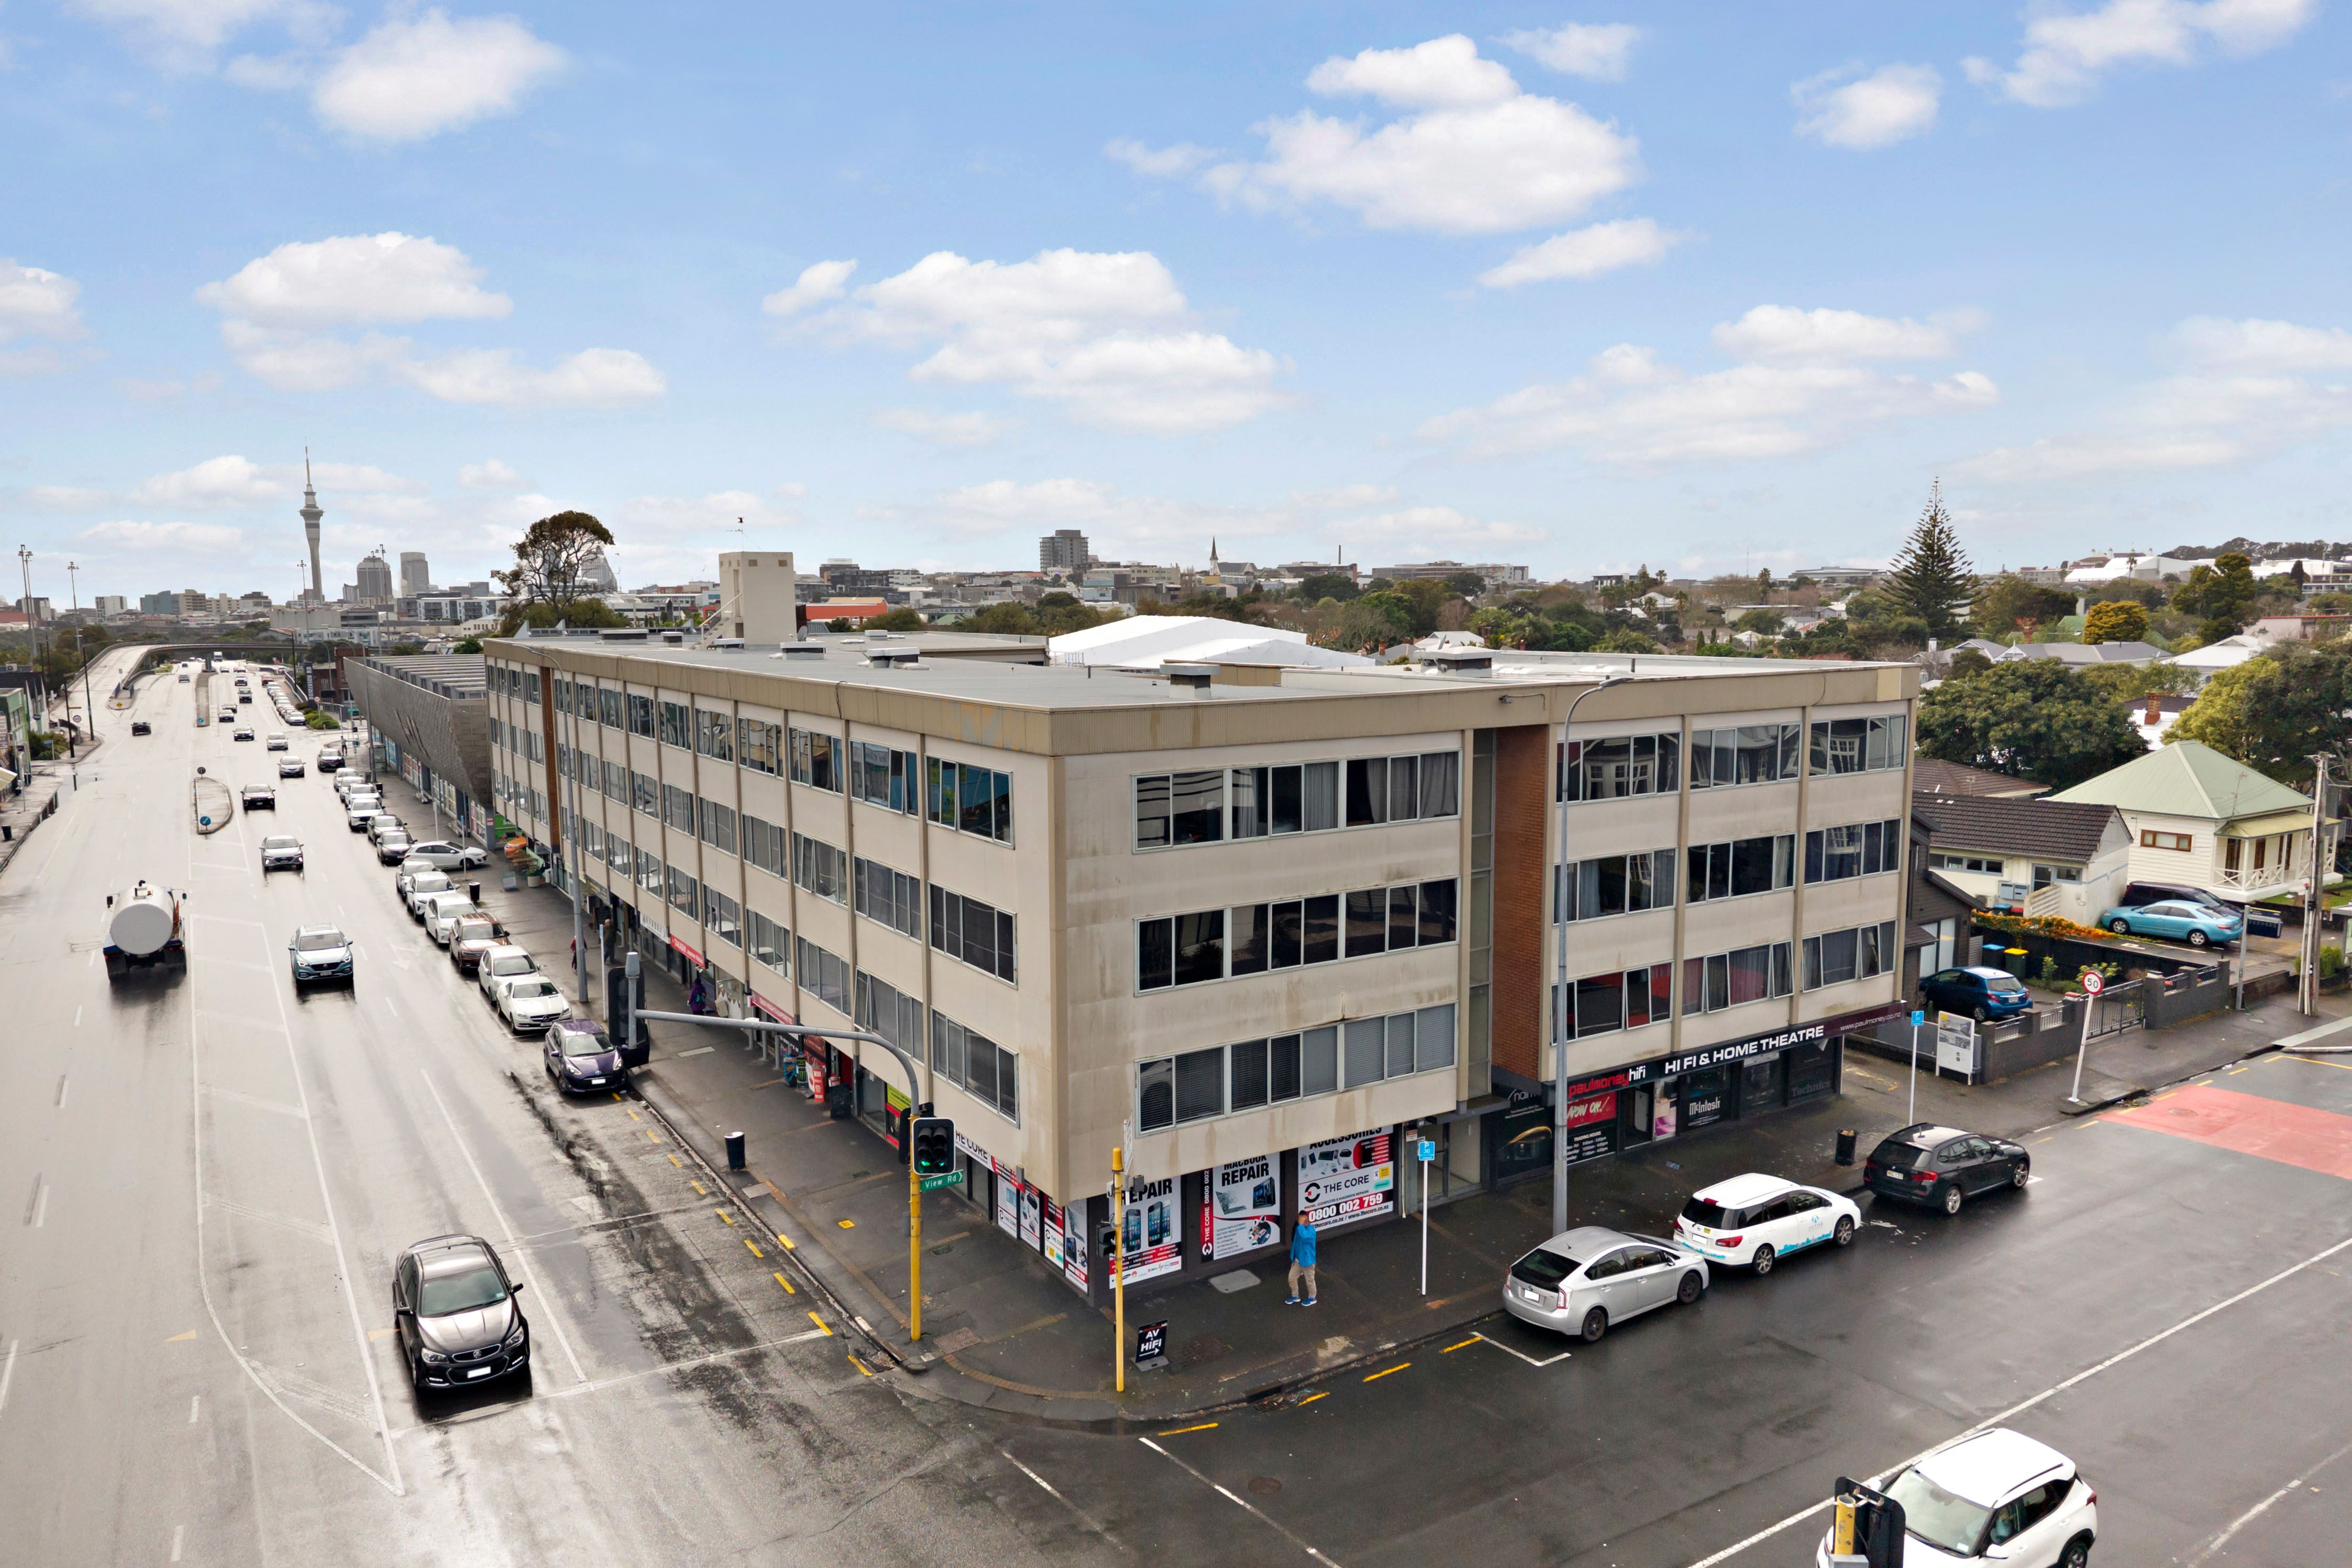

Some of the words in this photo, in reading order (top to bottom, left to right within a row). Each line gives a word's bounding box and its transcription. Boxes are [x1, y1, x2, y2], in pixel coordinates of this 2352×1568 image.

[2087, 977, 2099, 989] 50
[1840, 1012, 1901, 1031] www.paulmoney.co.nz
[1665, 1060, 1680, 1074] HI
[1684, 1055, 1697, 1070] FI
[1699, 1053, 1710, 1065] &
[1713, 1042, 1758, 1063] HOME
[1760, 1025, 1825, 1051] THEATRE
[1567, 1103, 1588, 1120] NOW
[1689, 1097, 1720, 1116] McIntosh
[925, 1179, 942, 1188] View
[948, 1174, 956, 1183] Rd
[1221, 1162, 1269, 1186] REPAIR
[1323, 1181, 1342, 1194] THE
[1344, 1174, 1369, 1189] CORE
[1308, 1205, 1336, 1222] 0800
[1339, 1199, 1360, 1214] 002
[1363, 1193, 1383, 1207] 759
[1145, 1329, 1160, 1339] AV
